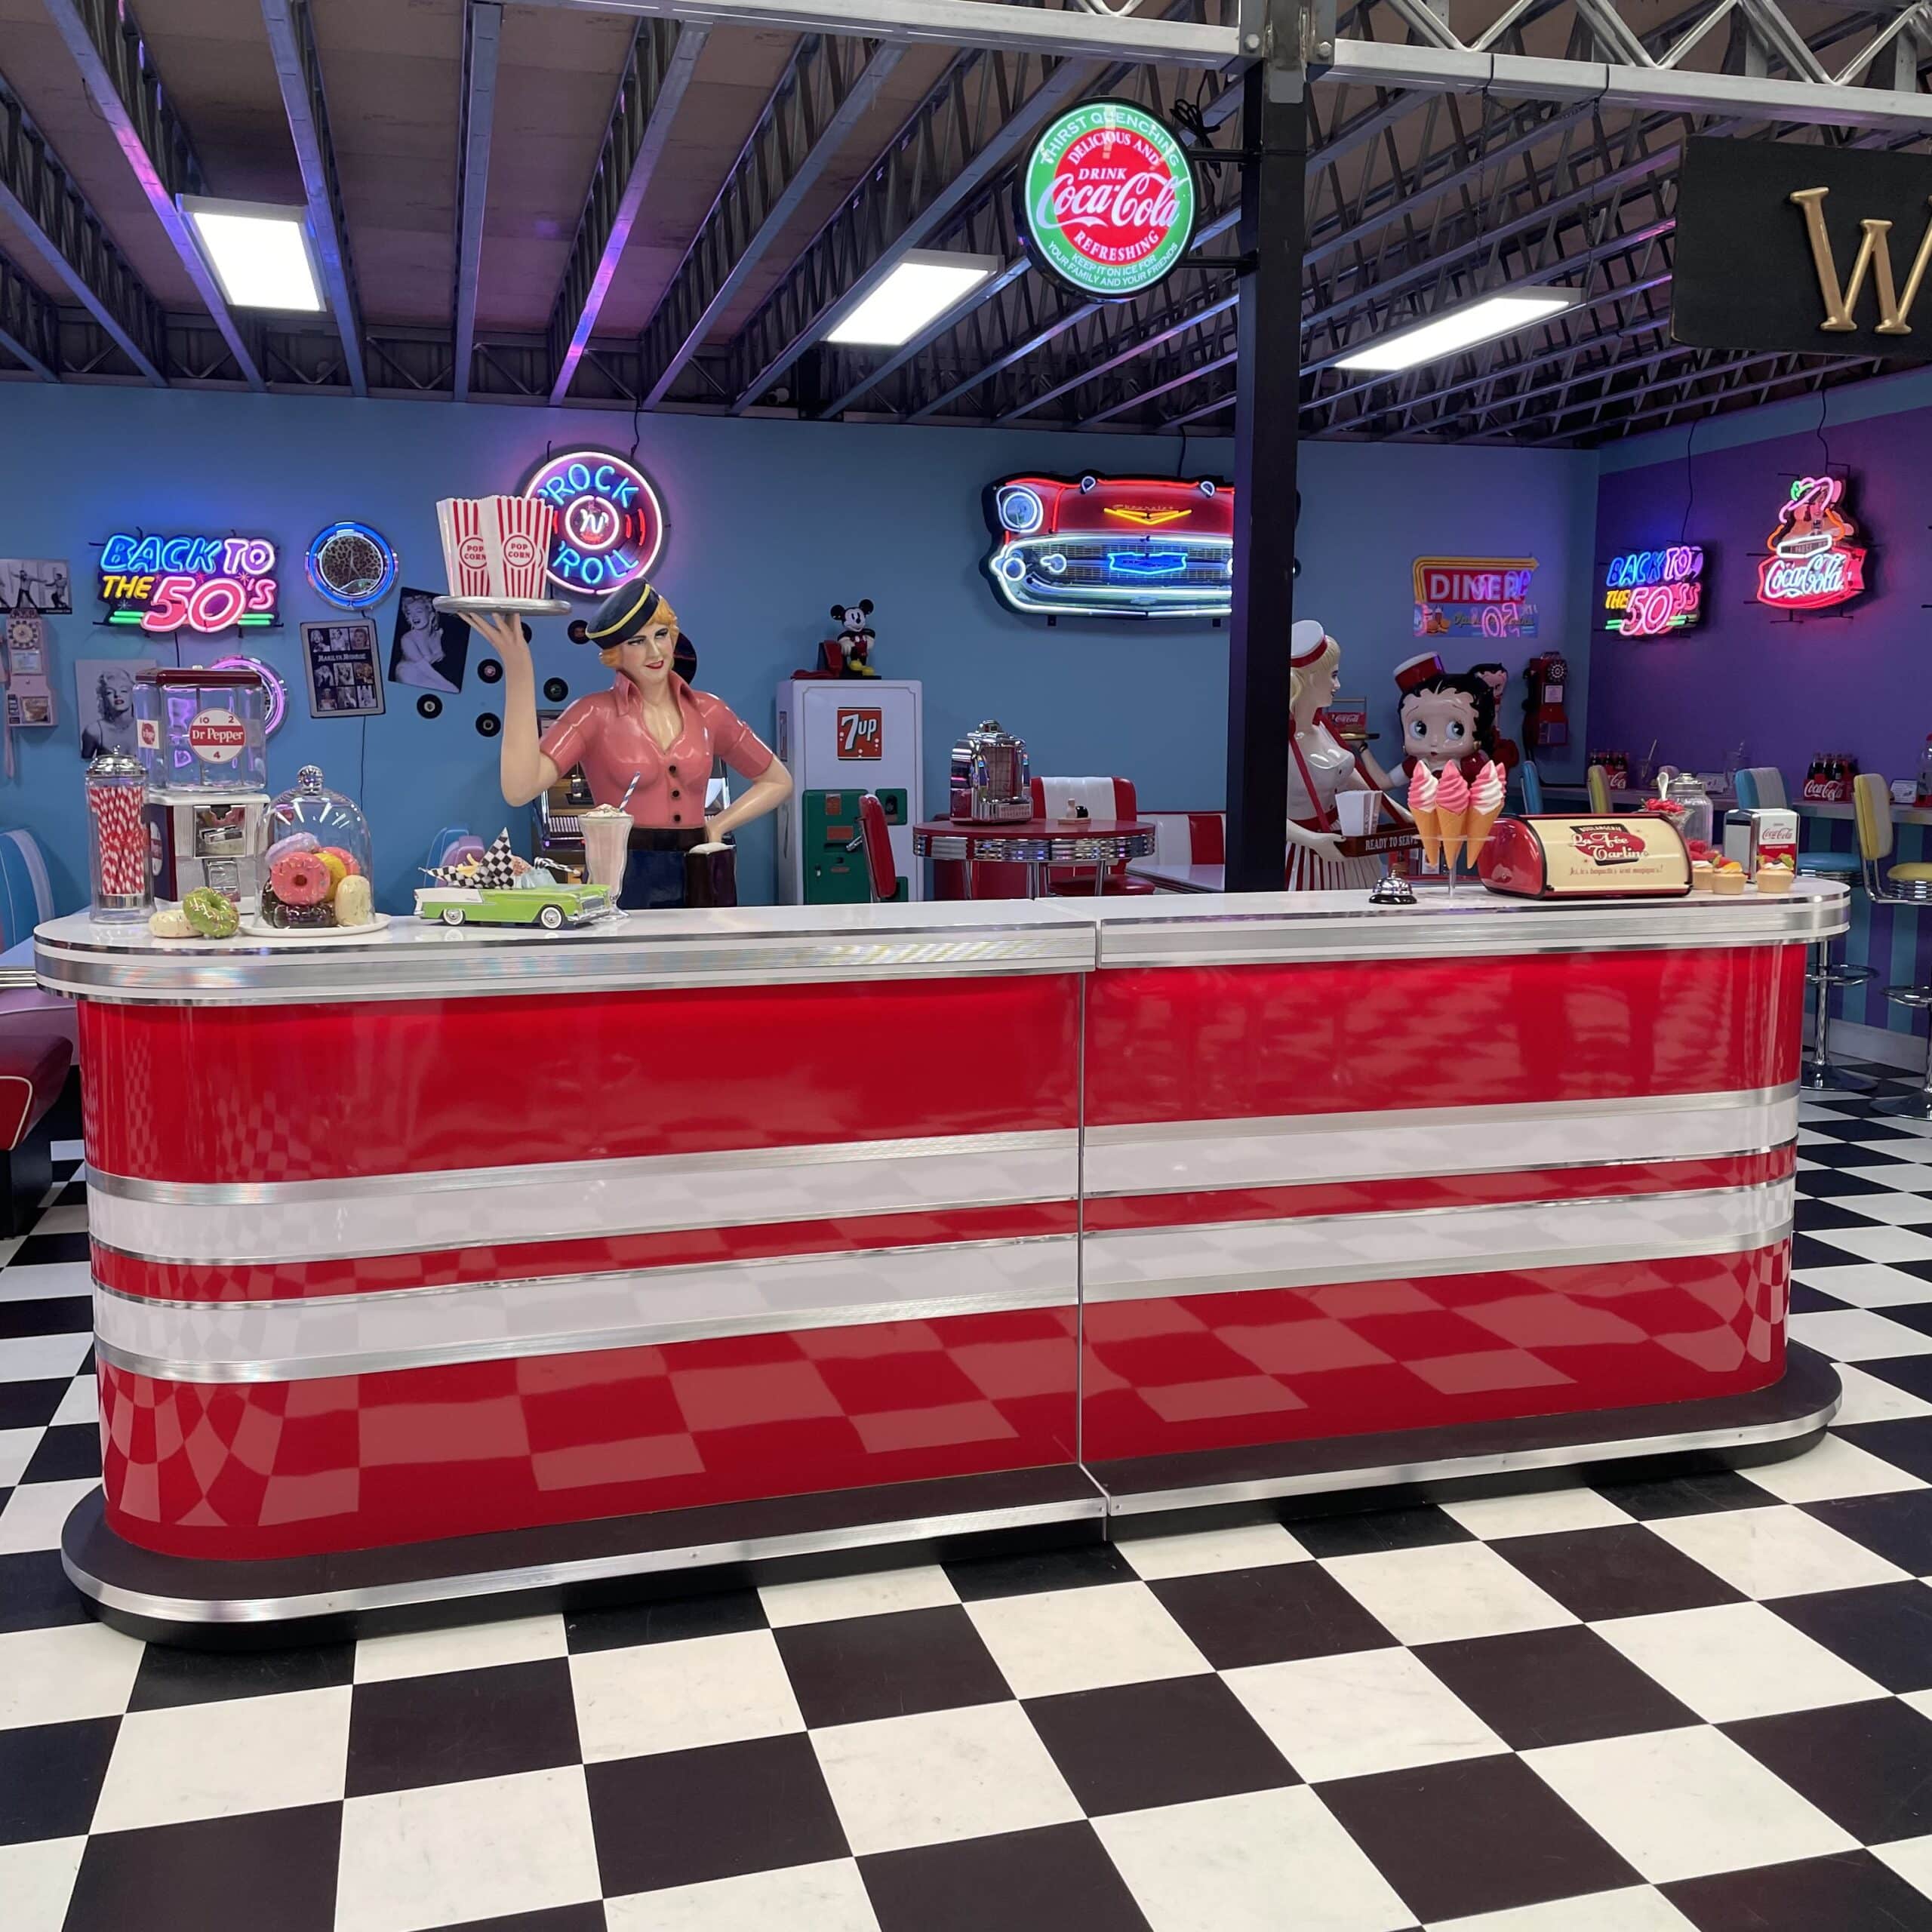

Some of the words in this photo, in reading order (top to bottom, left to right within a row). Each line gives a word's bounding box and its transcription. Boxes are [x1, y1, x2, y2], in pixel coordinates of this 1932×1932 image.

[1041, 116, 1088, 165] THIRST
[1091, 111, 1180, 166] QUENCHING
[1067, 131, 1131, 165] DELICIOUS
[1133, 139, 1160, 165] AND
[1078, 168, 1128, 180] DRINK
[1074, 229, 1159, 261] REFRESHING
[1048, 241, 1070, 267] YOUR
[1067, 261, 1100, 283] FAMILY
[1100, 278, 1121, 287] AND
[1122, 270, 1147, 285] YOUR
[1147, 242, 1179, 278] FRIENDS
[1072, 253, 1098, 272] KEEP
[1097, 266, 1106, 274] IT
[1106, 267, 1121, 277] ON
[1122, 265, 1138, 275] ICE
[1139, 254, 1158, 270] FOR
[100, 534, 223, 574] BACK
[223, 538, 275, 575] TO
[1606, 550, 1666, 586] BACK
[1663, 546, 1694, 581] TO
[103, 575, 155, 599] THE
[1430, 574, 1522, 601] DINER
[1605, 589, 1631, 610] THE
[192, 730, 207, 740] Dr
[207, 728, 244, 743] Pepper
[214, 751, 221, 759] 4
[1365, 837, 1388, 851] READY
[1389, 835, 1398, 848] TO
[1571, 833, 1592, 847] La
